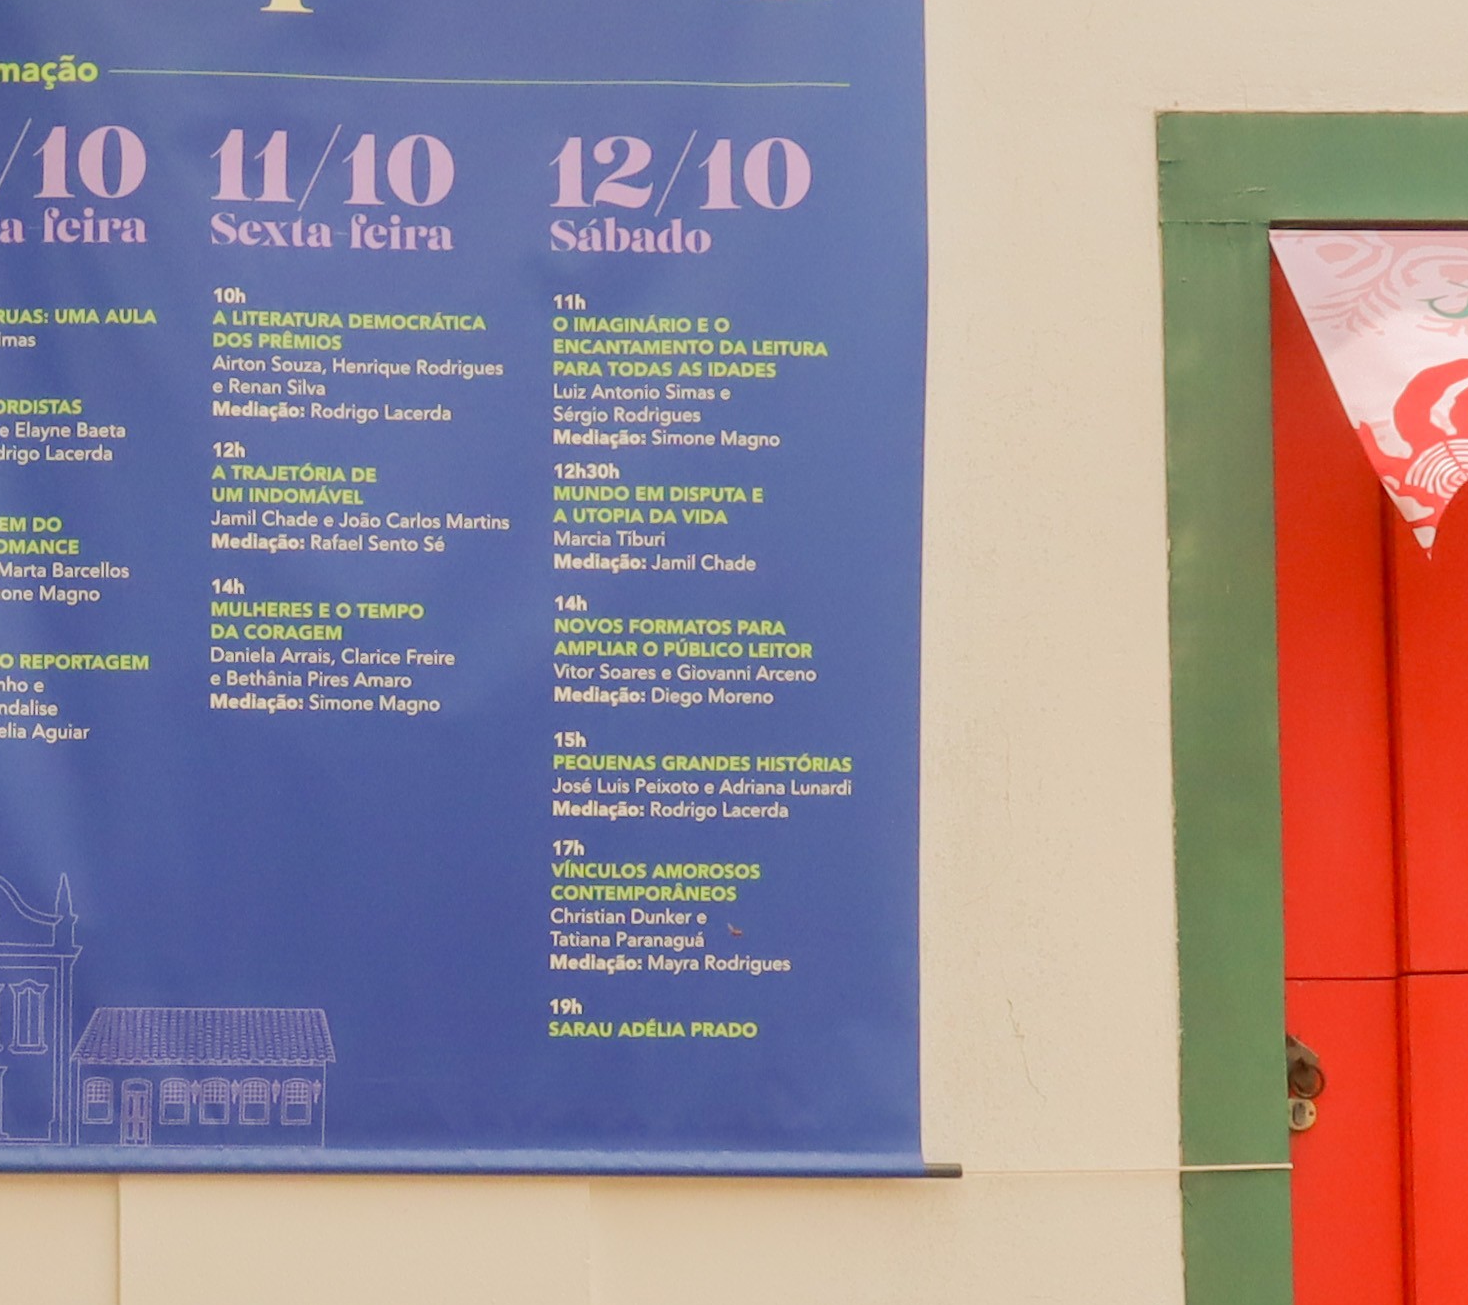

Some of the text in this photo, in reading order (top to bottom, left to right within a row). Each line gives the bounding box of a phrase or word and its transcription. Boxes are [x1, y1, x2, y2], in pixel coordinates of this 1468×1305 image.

[210, 124, 454, 211] 11/10
[549, 130, 811, 217] 12/10
[550, 217, 712, 254] Sábado
[214, 287, 246, 303] 10h
[554, 294, 586, 310] 11h
[55, 309, 100, 324] UMA
[105, 309, 157, 324] AULA
[213, 310, 486, 330] A LITERATURA DEMOCRÁTICA
[213, 331, 341, 350] DOS PRÊMIOS
[553, 339, 828, 356] ENCANTAMENTO DA LEITURA
[212, 355, 503, 380] Airton Souza, Henrique Rodrigues
[553, 361, 776, 378] PARA TODAS AS IDADES
[213, 400, 451, 424] Mediação: Rodrigo Lacerda
[553, 406, 701, 426] Sérgio Rodrigues
[213, 441, 245, 458] 12h
[553, 429, 780, 451] Mediação: Simone Magno
[46, 444, 112, 461] Lacerda
[212, 463, 377, 483] A TRAJETÓRIA DE
[554, 463, 619, 479] 12h30h
[212, 486, 363, 505] UM INDOMÁVEL
[554, 486, 763, 503] MUNDO EM DISPUTA E
[33, 517, 62, 532] DO
[553, 508, 728, 524] A UTOPIA DA VIDA
[211, 533, 445, 553] Mediação: Rafael Sento Sé
[554, 531, 665, 547] Marcia Tiburi
[554, 553, 756, 573] Mediação: Jamil Chade
[40, 585, 100, 606] Magno
[212, 578, 244, 594] 14h
[211, 601, 424, 619] MULHERES E O TEMPO
[555, 595, 587, 611] 14h
[211, 624, 342, 640] DA CORAGEM
[554, 618, 786, 635] NOVOS FORMATOS PARA
[211, 647, 455, 666] Daniela Arrais, Clarice Freire
[554, 638, 812, 658] AMPLIAR O PÚBLICO LEITOR
[20, 654, 149, 670] REPORTAGEM
[210, 692, 440, 715] Mediação: Simone Magno
[554, 686, 774, 708] Mediação: Diego Moreno
[32, 723, 90, 743] Aguiar
[554, 731, 586, 747] 15h
[553, 753, 852, 772] PEQUENAS GRANDES HISTÓRIAS
[553, 800, 789, 821] Mediação: Rodrigo Lacerda
[553, 840, 584, 856] 17h
[551, 859, 760, 879] VÍNCULOS AMOROSOS
[551, 883, 737, 902] CONTEMPORÂNEOS
[550, 931, 704, 952] Tatiana Paranaguá
[550, 953, 791, 975] Mediação: Mayra Rodrigues
[550, 998, 582, 1014] 19h
[549, 1018, 758, 1038] SARAU ADÉLIA PRADO
